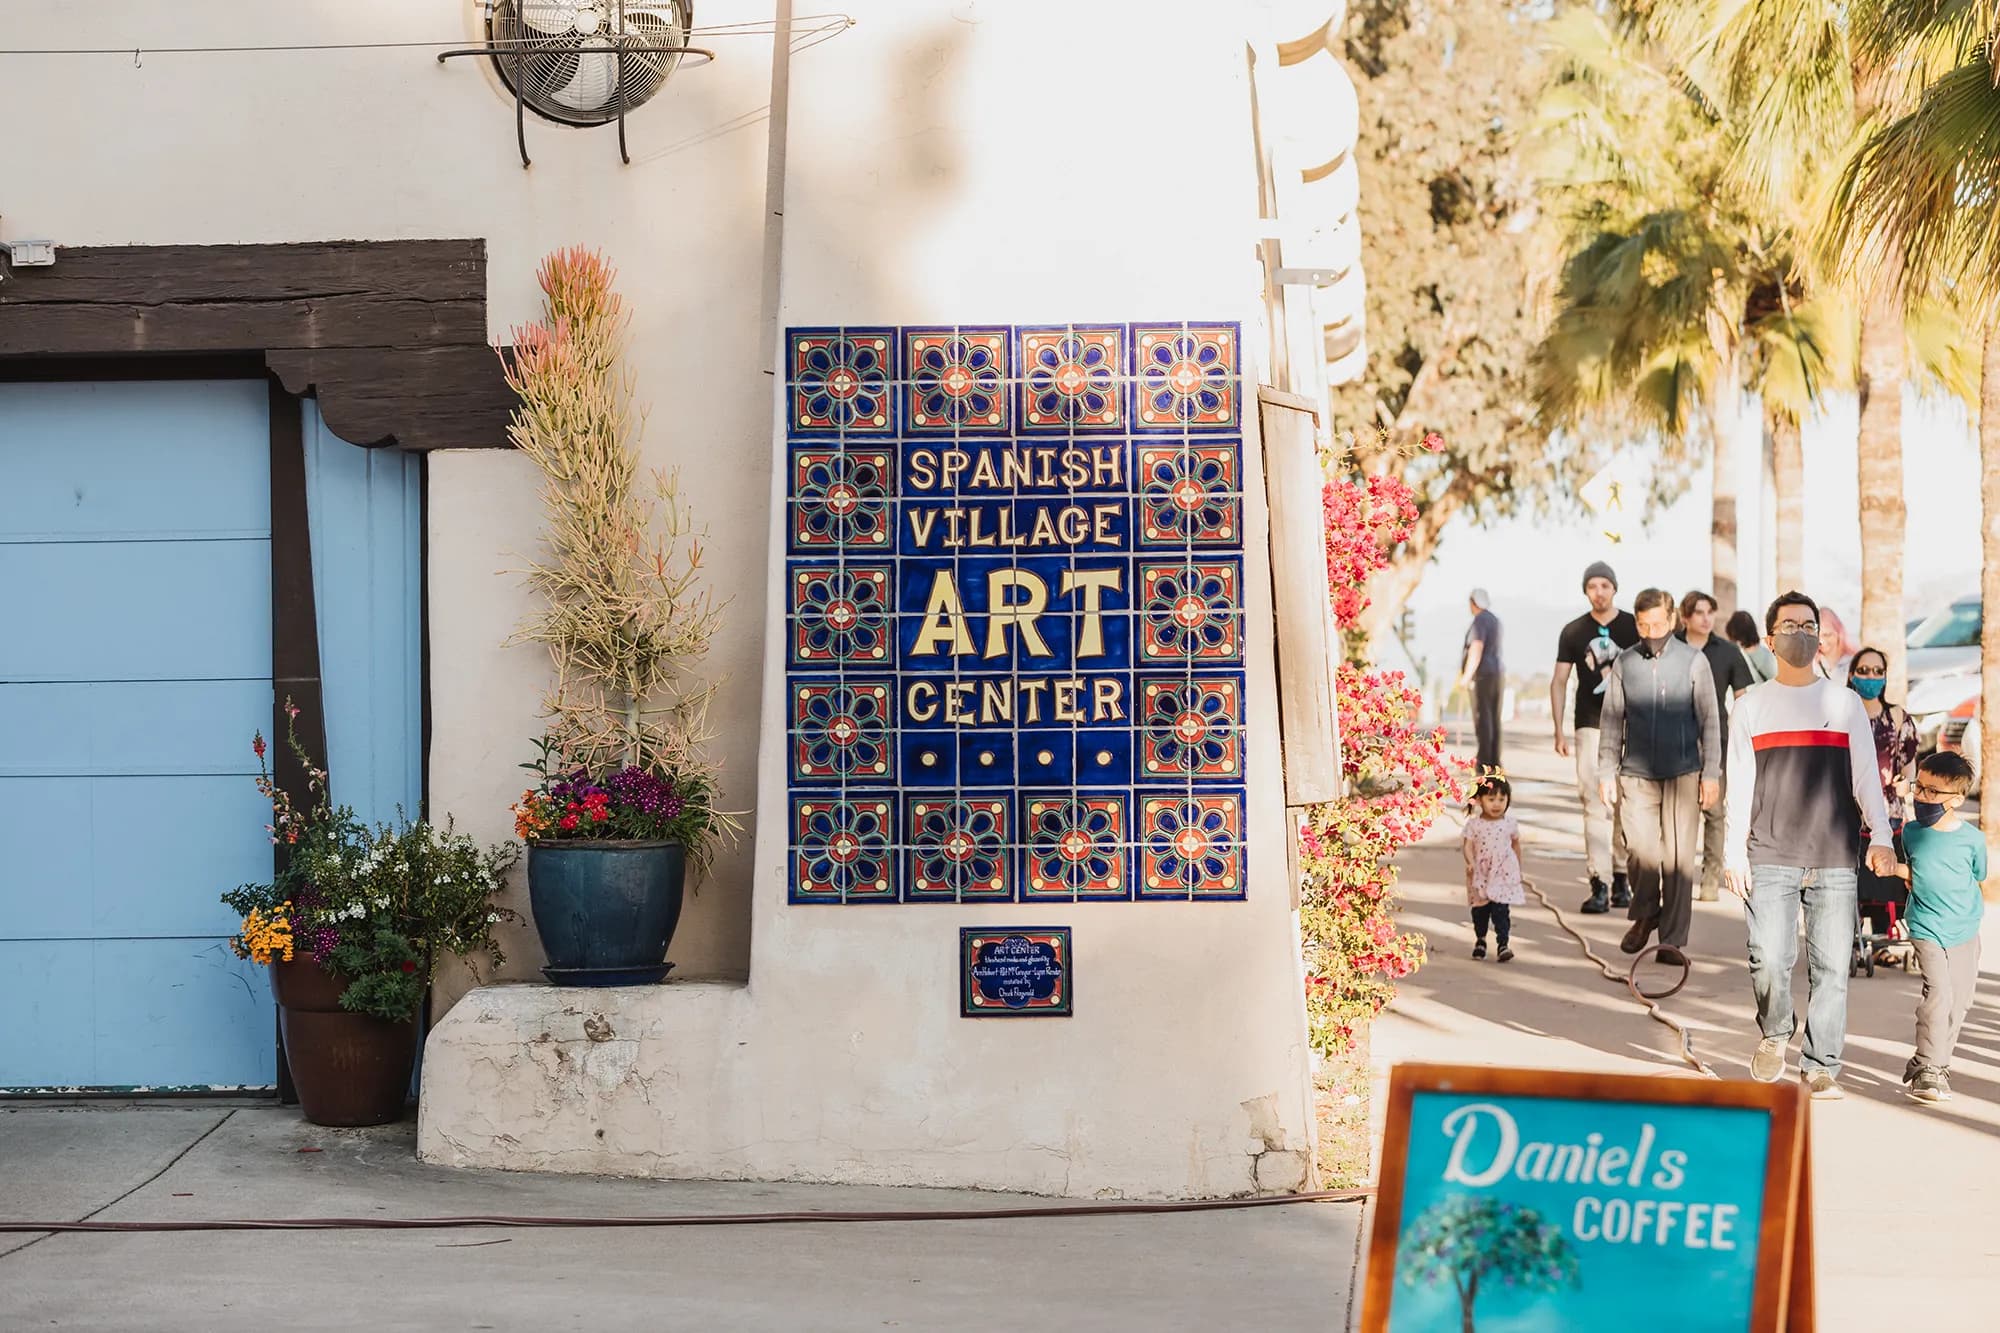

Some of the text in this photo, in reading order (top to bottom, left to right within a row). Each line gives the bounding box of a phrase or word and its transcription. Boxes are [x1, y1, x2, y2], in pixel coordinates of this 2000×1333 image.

[908, 446, 1124, 491] SPANISH
[907, 503, 1123, 548] VILLAGE
[909, 567, 1124, 660] ART
[906, 677, 1128, 726] CENTER
[994, 946, 1040, 955] ART CENTER
[1441, 1103, 1689, 1190] Daniels
[1573, 1196, 1740, 1251] COFFEE
